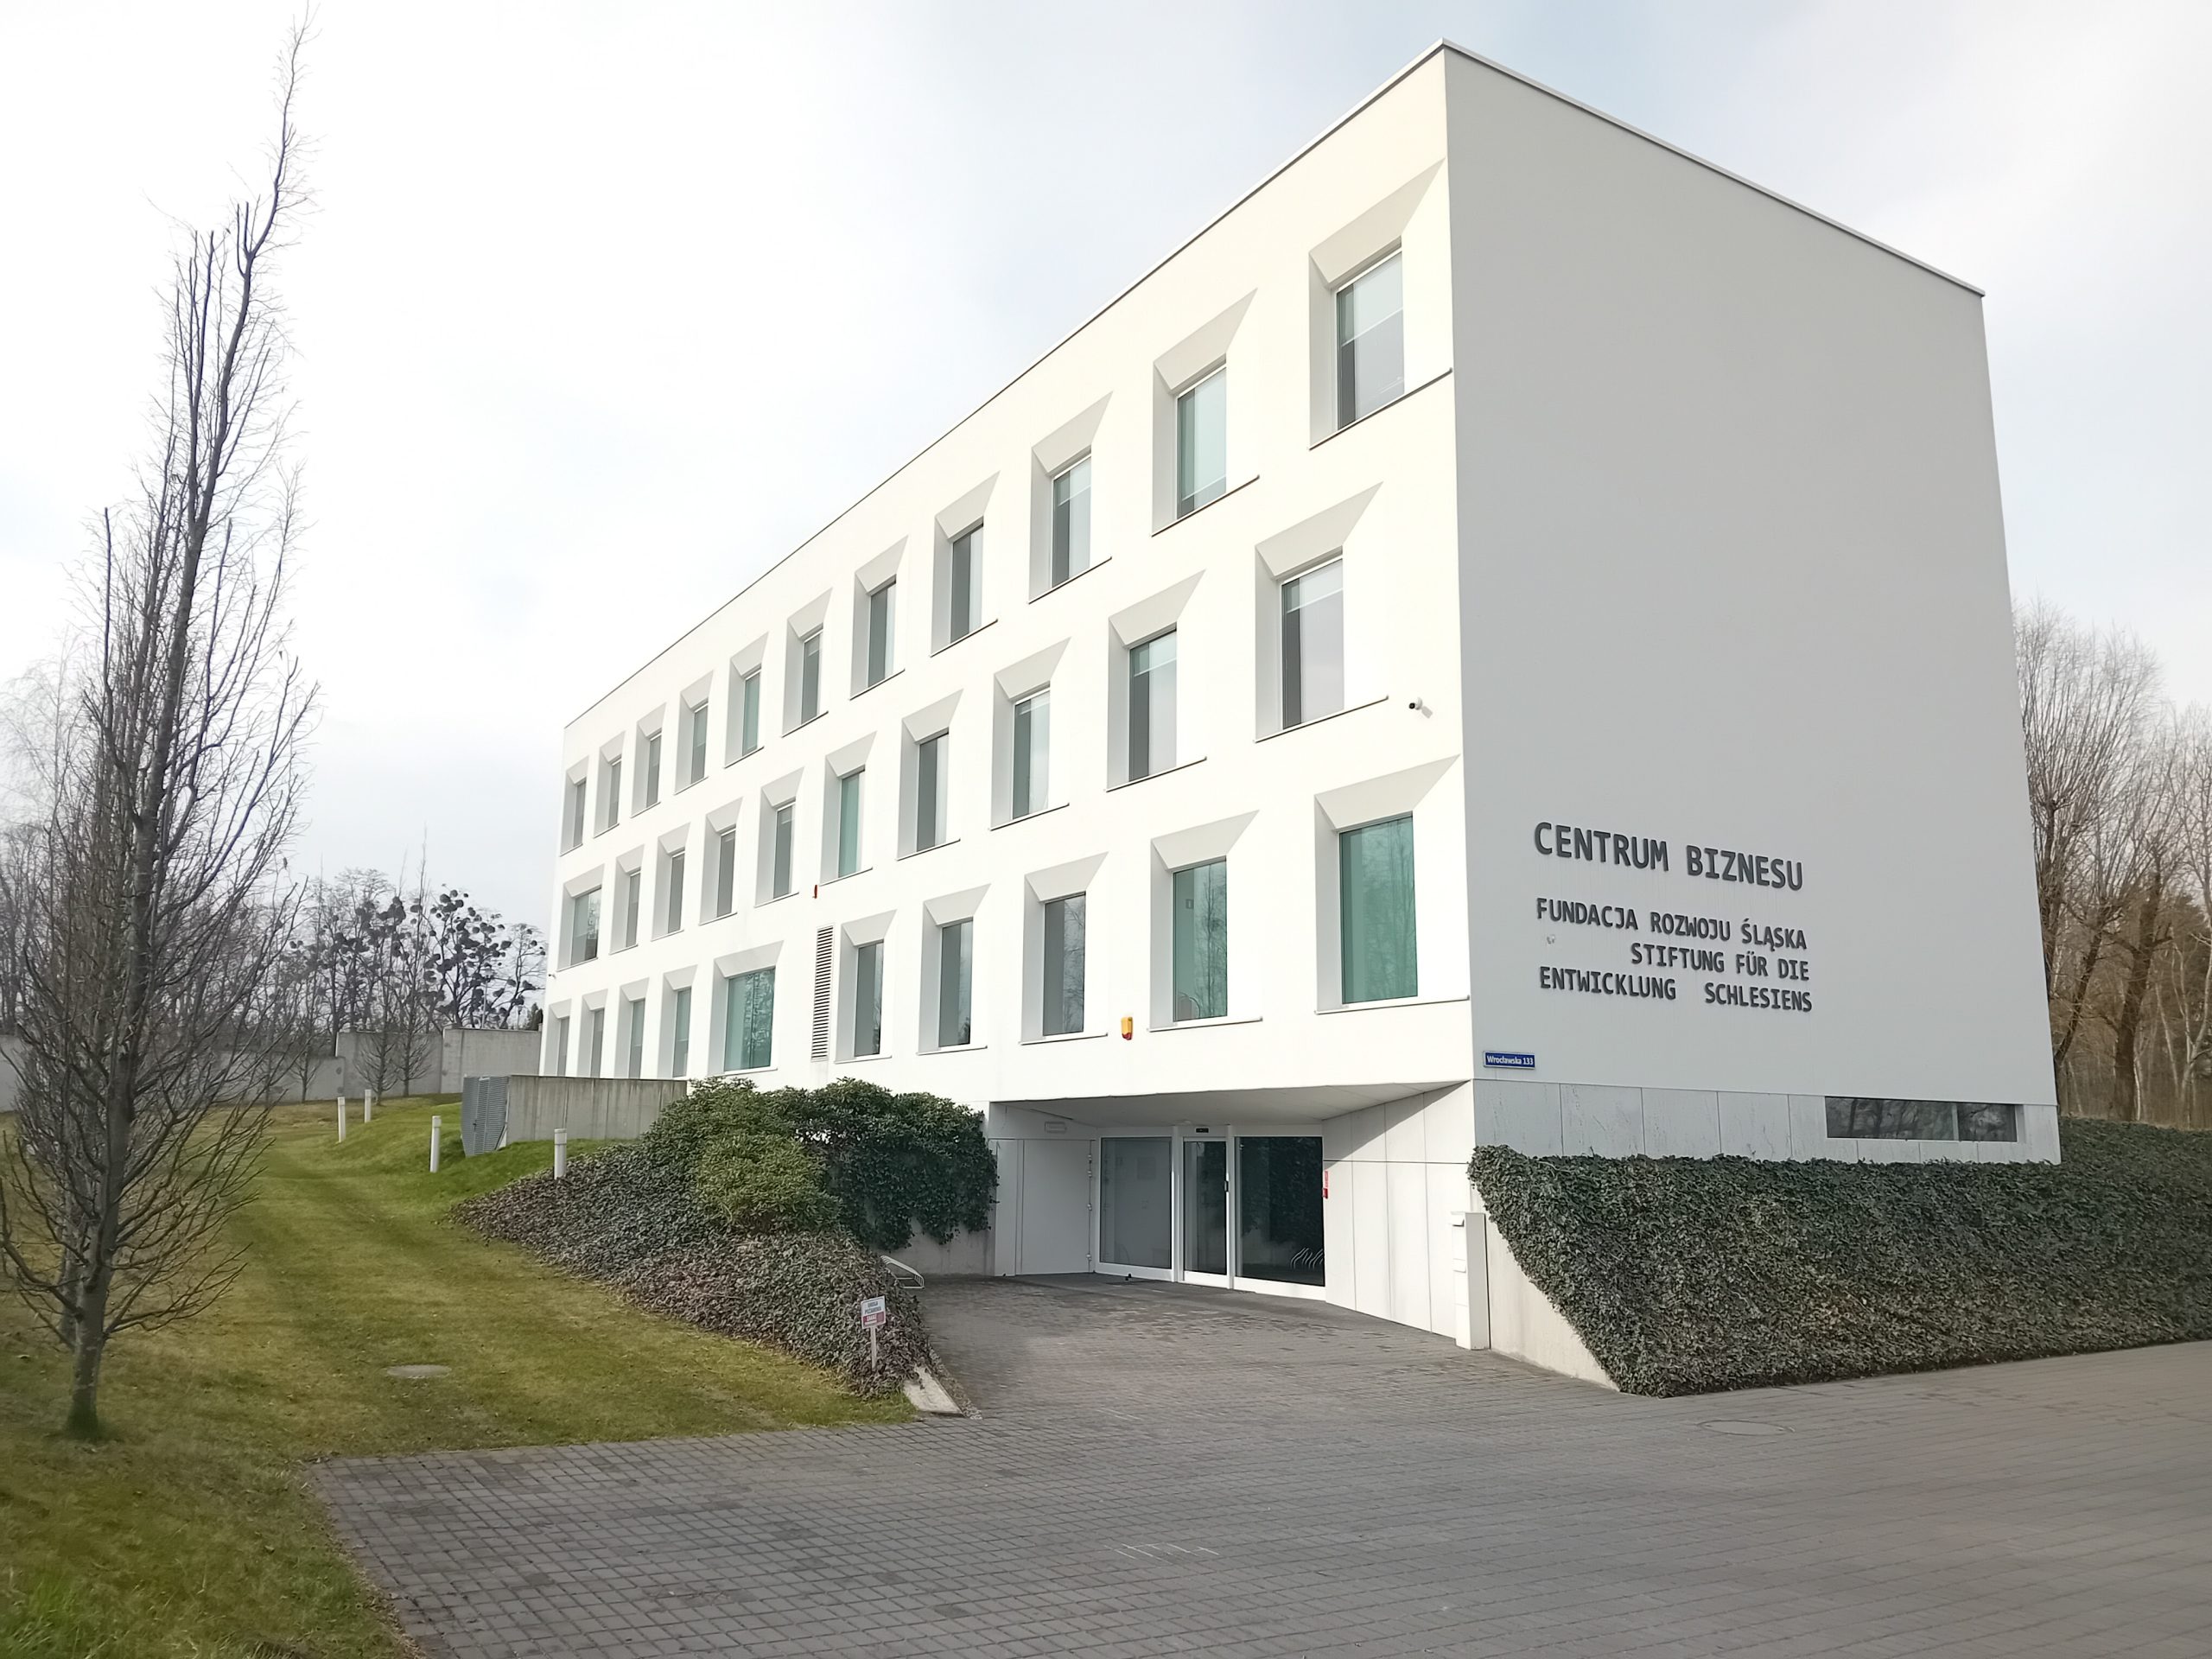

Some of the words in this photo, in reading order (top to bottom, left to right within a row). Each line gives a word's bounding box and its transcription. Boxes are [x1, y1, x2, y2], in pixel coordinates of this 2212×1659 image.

[1535, 822, 1669, 871] CENTRUM
[1687, 845, 1803, 890] BIZNESU
[1537, 898, 1638, 930] FUNDACJA
[1650, 912, 1731, 941] ROZWOJU
[1741, 918, 1807, 951] ŚLĄSKA
[1630, 942, 1725, 973] STIFTUNG
[1736, 950, 1768, 976] FÜR
[1778, 959, 1809, 981] DIE
[1540, 966, 1676, 1000] ENTWICKLUNG
[1704, 982, 1812, 1012] SCHLESIENS
[1522, 1057, 1534, 1065] 133
